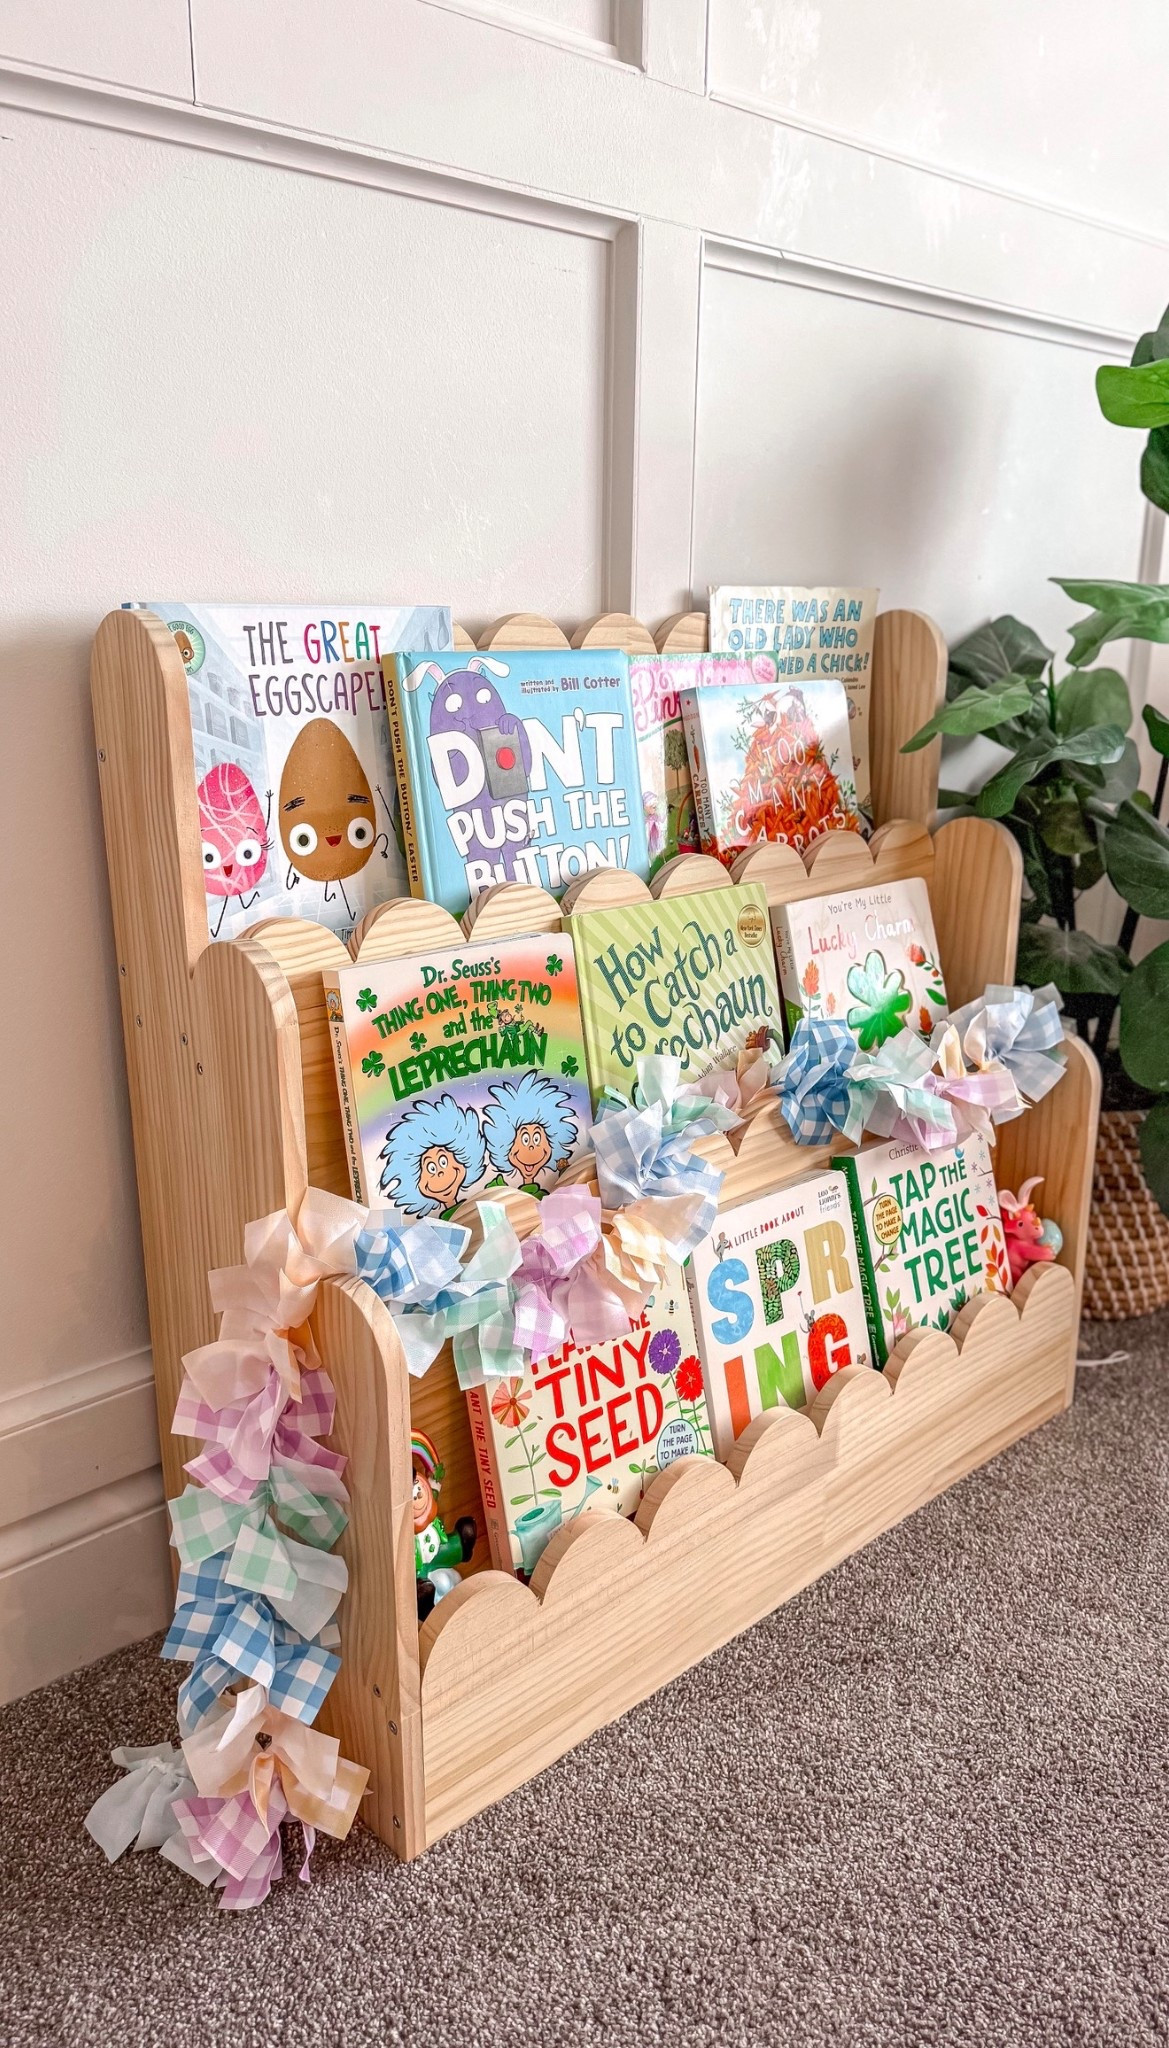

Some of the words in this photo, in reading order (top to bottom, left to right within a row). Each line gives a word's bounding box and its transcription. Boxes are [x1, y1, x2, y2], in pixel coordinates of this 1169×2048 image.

[729, 598, 785, 624] THERE
[792, 598, 829, 623] WAS
[833, 599, 862, 621] AN
[243, 621, 293, 666] THE
[304, 620, 381, 664] GREAT
[728, 627, 767, 651] OLD
[773, 625, 815, 652] LADY
[819, 626, 858, 649] WHO
[807, 653, 817, 673] A
[821, 652, 870, 673] CHICK!
[248, 671, 387, 717] EGGSCAPE!
[561, 678, 579, 691] Bill
[584, 677, 620, 689] Cotter
[762, 738, 805, 771] TOO
[388, 680, 398, 716] DON'T
[393, 721, 401, 753] PUSH
[408, 843, 418, 882] EASTER
[748, 773, 827, 814] MANY
[693, 774, 705, 828] CARROTS
[702, 797, 711, 820] MANY
[447, 797, 557, 857] PUSH
[564, 789, 630, 830] THE
[827, 901, 853, 915] You're
[855, 898, 867, 909] My
[869, 894, 892, 907] Little
[808, 924, 857, 960] Lucky
[865, 911, 915, 941] Charm
[420, 966, 447, 988] Dr.
[450, 957, 501, 980] Seuss's
[593, 926, 664, 1012] How
[372, 997, 424, 1039] THING
[425, 985, 468, 1015] ONE,
[470, 979, 517, 1004] THING
[518, 980, 552, 1006] TWO
[611, 1022, 646, 1067] to
[644, 921, 722, 1028] Catch
[723, 928, 738, 956] a
[443, 1012, 467, 1038] and
[470, 1007, 493, 1032] the
[388, 1032, 548, 1101] LEPRECHAUN
[889, 1162, 936, 1210] TAP
[939, 1159, 967, 1187] THE
[876, 1211, 885, 1220] THE
[885, 1206, 898, 1217] PAGE
[879, 1199, 892, 1209] TURN
[734, 1227, 758, 1246] LITTLE
[760, 1217, 779, 1234] BOOK
[782, 1205, 805, 1224] ABOUT
[881, 1226, 899, 1240] CHANGE
[884, 1218, 896, 1229] MAKE
[900, 1188, 974, 1254] MAGIC
[855, 1234, 863, 1254] THE
[858, 1257, 869, 1291] MAGIC
[904, 1229, 983, 1304] TREE
[535, 1331, 651, 1418] TINY
[475, 1420, 486, 1442] THE
[545, 1383, 664, 1487] SEED
[663, 1438, 674, 1448] THE
[676, 1434, 693, 1445] PAGE
[670, 1424, 686, 1434] TURN
[478, 1448, 491, 1475] TINY
[660, 1451, 669, 1460] TO
[671, 1446, 688, 1458] MAKE
[690, 1445, 695, 1453] A
[484, 1479, 496, 1509] SEED
